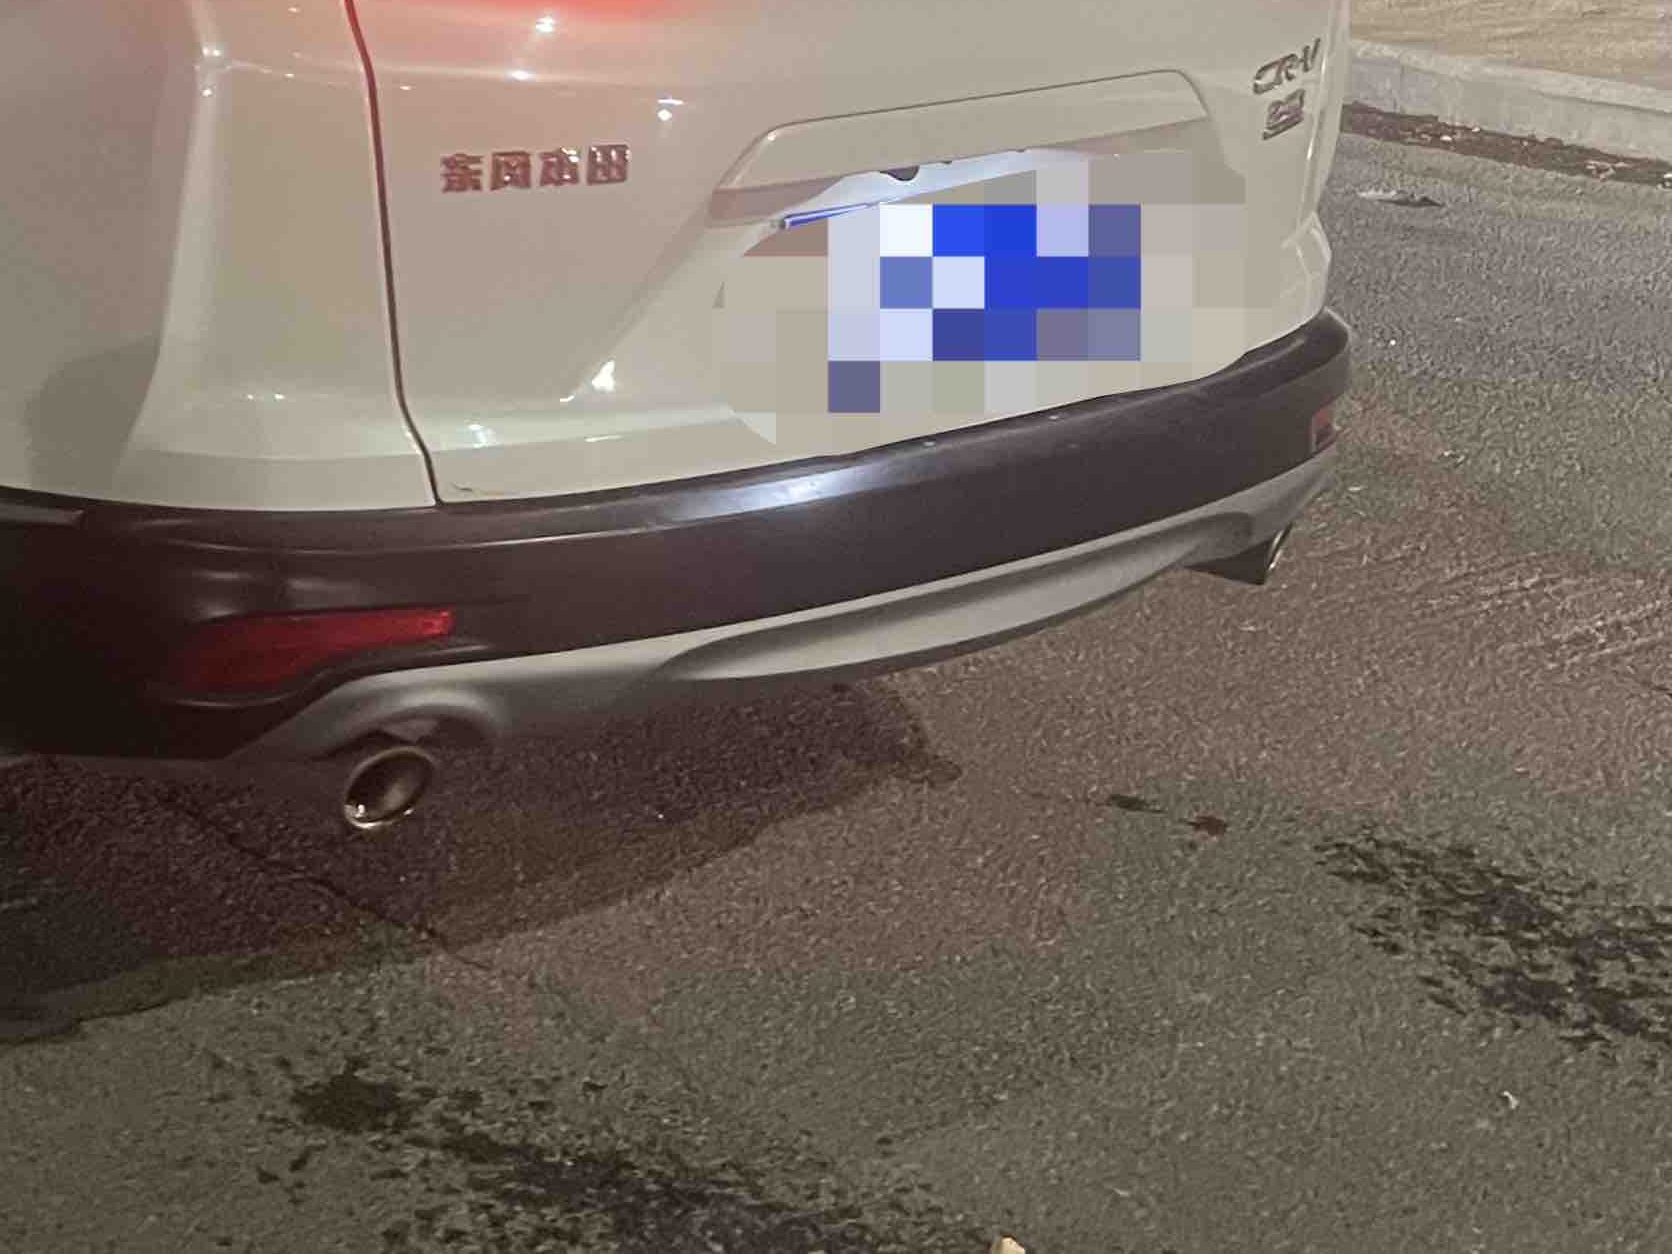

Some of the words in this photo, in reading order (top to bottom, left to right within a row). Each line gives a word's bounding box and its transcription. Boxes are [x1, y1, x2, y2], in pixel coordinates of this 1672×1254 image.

[1253, 37, 1321, 95] CR-V
[440, 144, 629, 192] 东风本田
